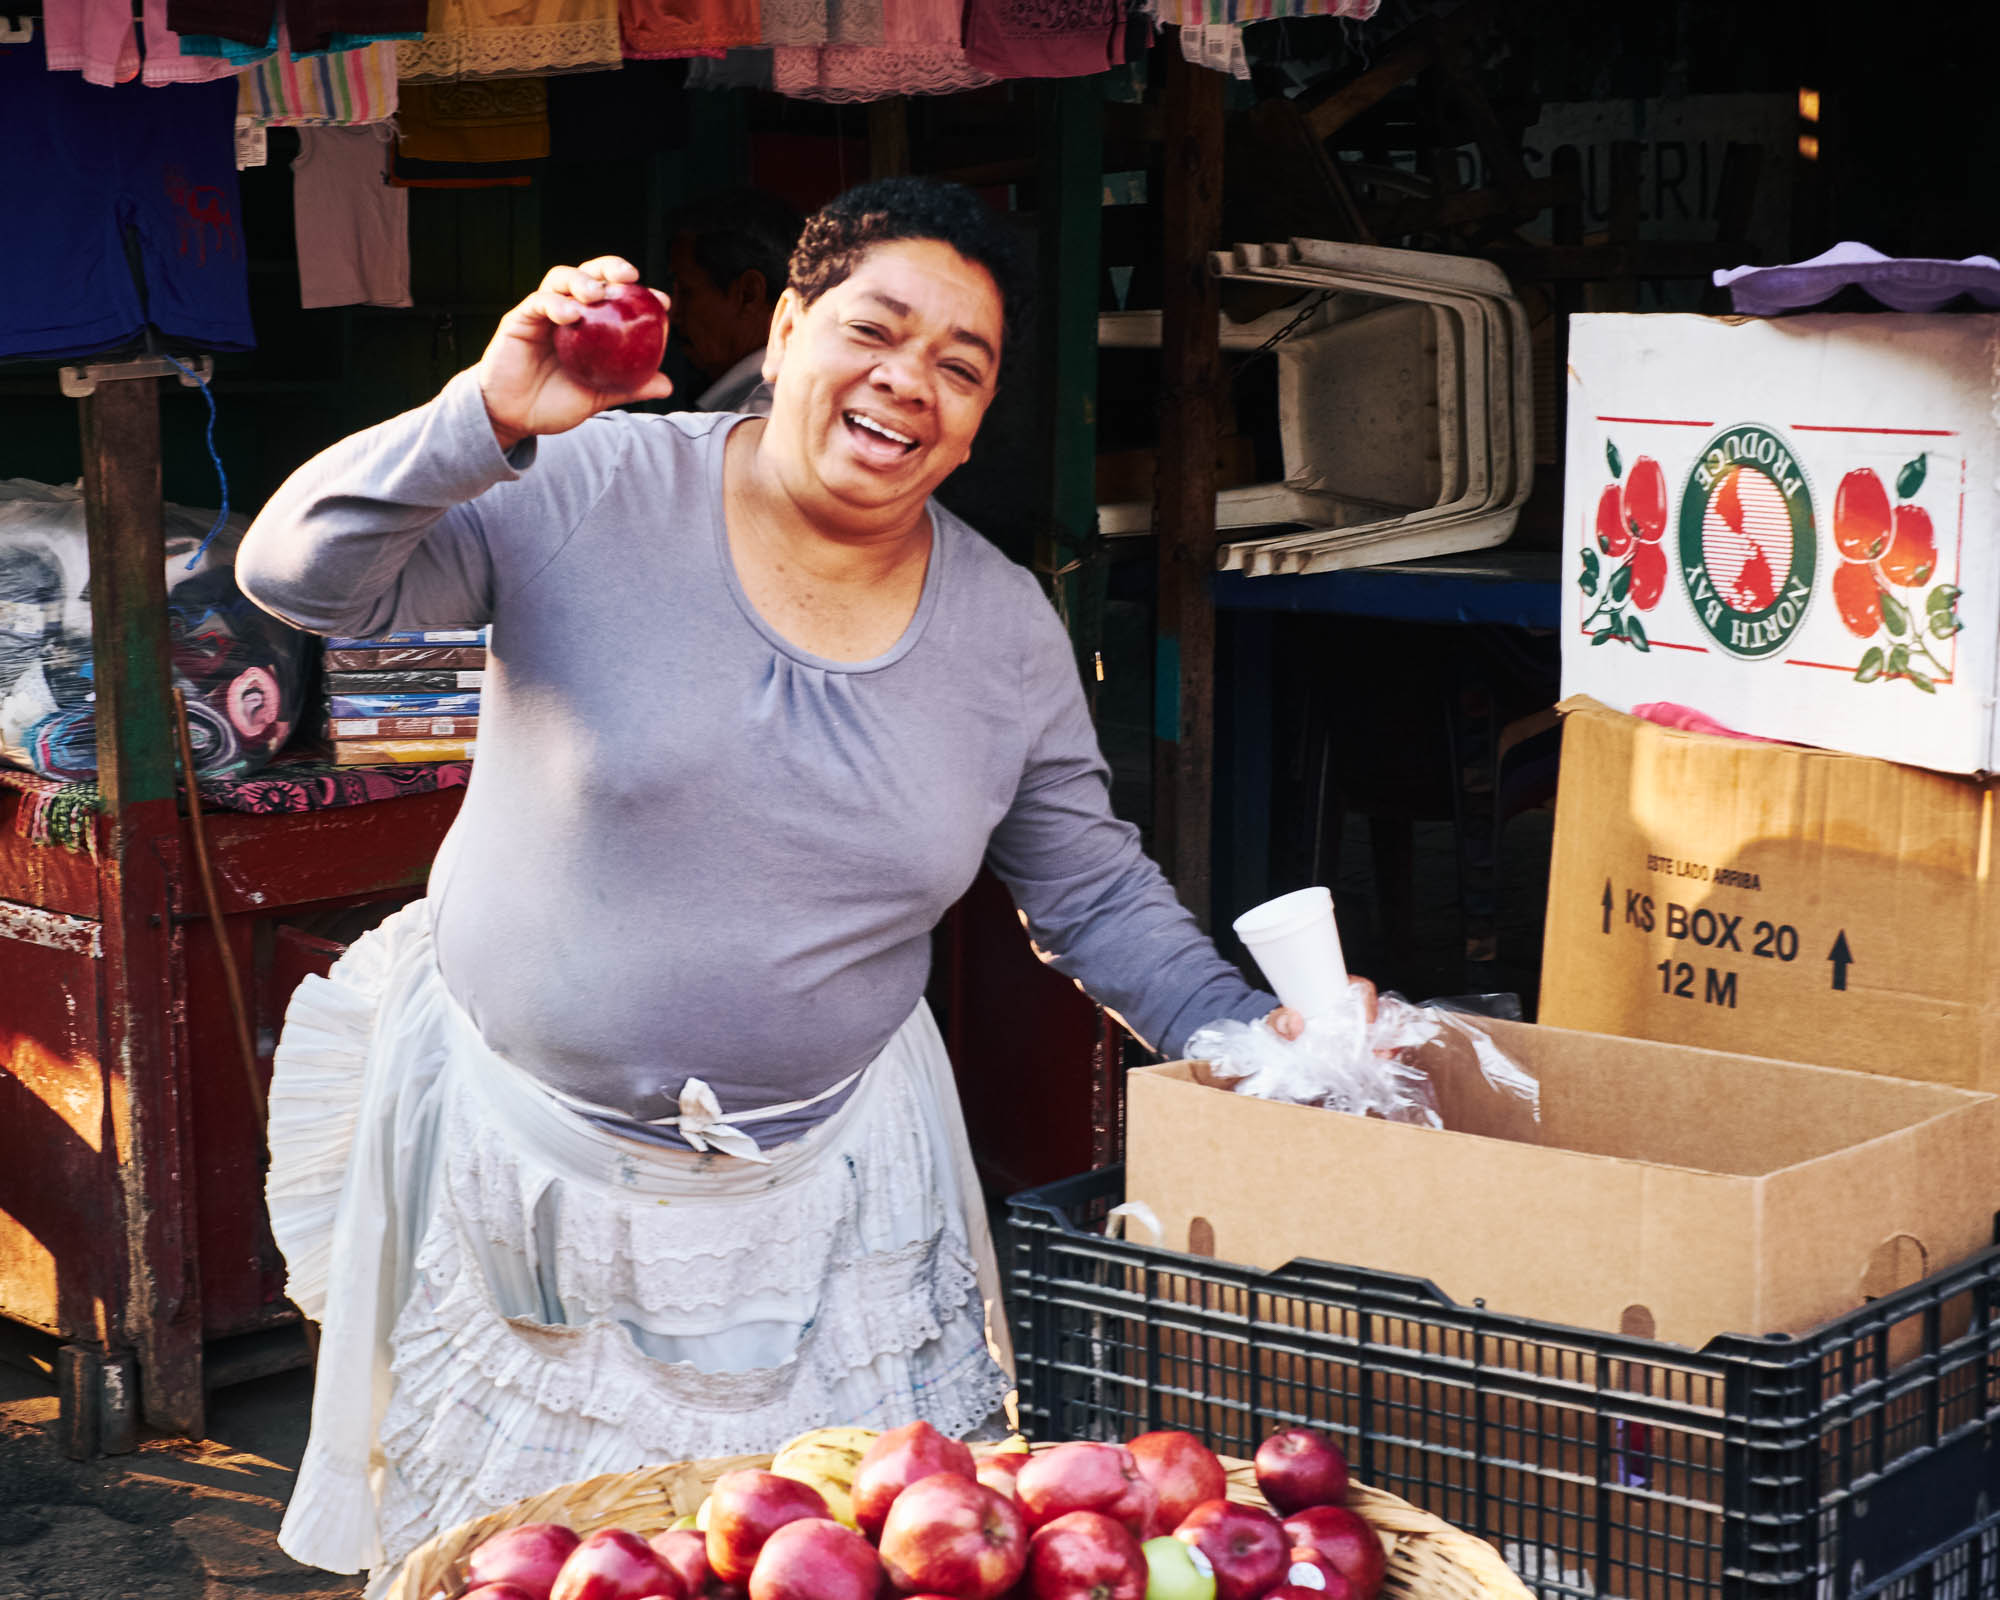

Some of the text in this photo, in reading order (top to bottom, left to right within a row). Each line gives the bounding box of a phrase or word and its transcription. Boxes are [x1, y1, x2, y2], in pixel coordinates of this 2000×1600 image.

[1694, 432, 1804, 499] PRODUCE
[1686, 563, 1811, 649] NORTH BAY
[1647, 854, 1762, 892] ESTE LADO ARRIBA
[1625, 888, 1799, 962] KS BOX 20
[1656, 959, 1738, 1009] 12 M
